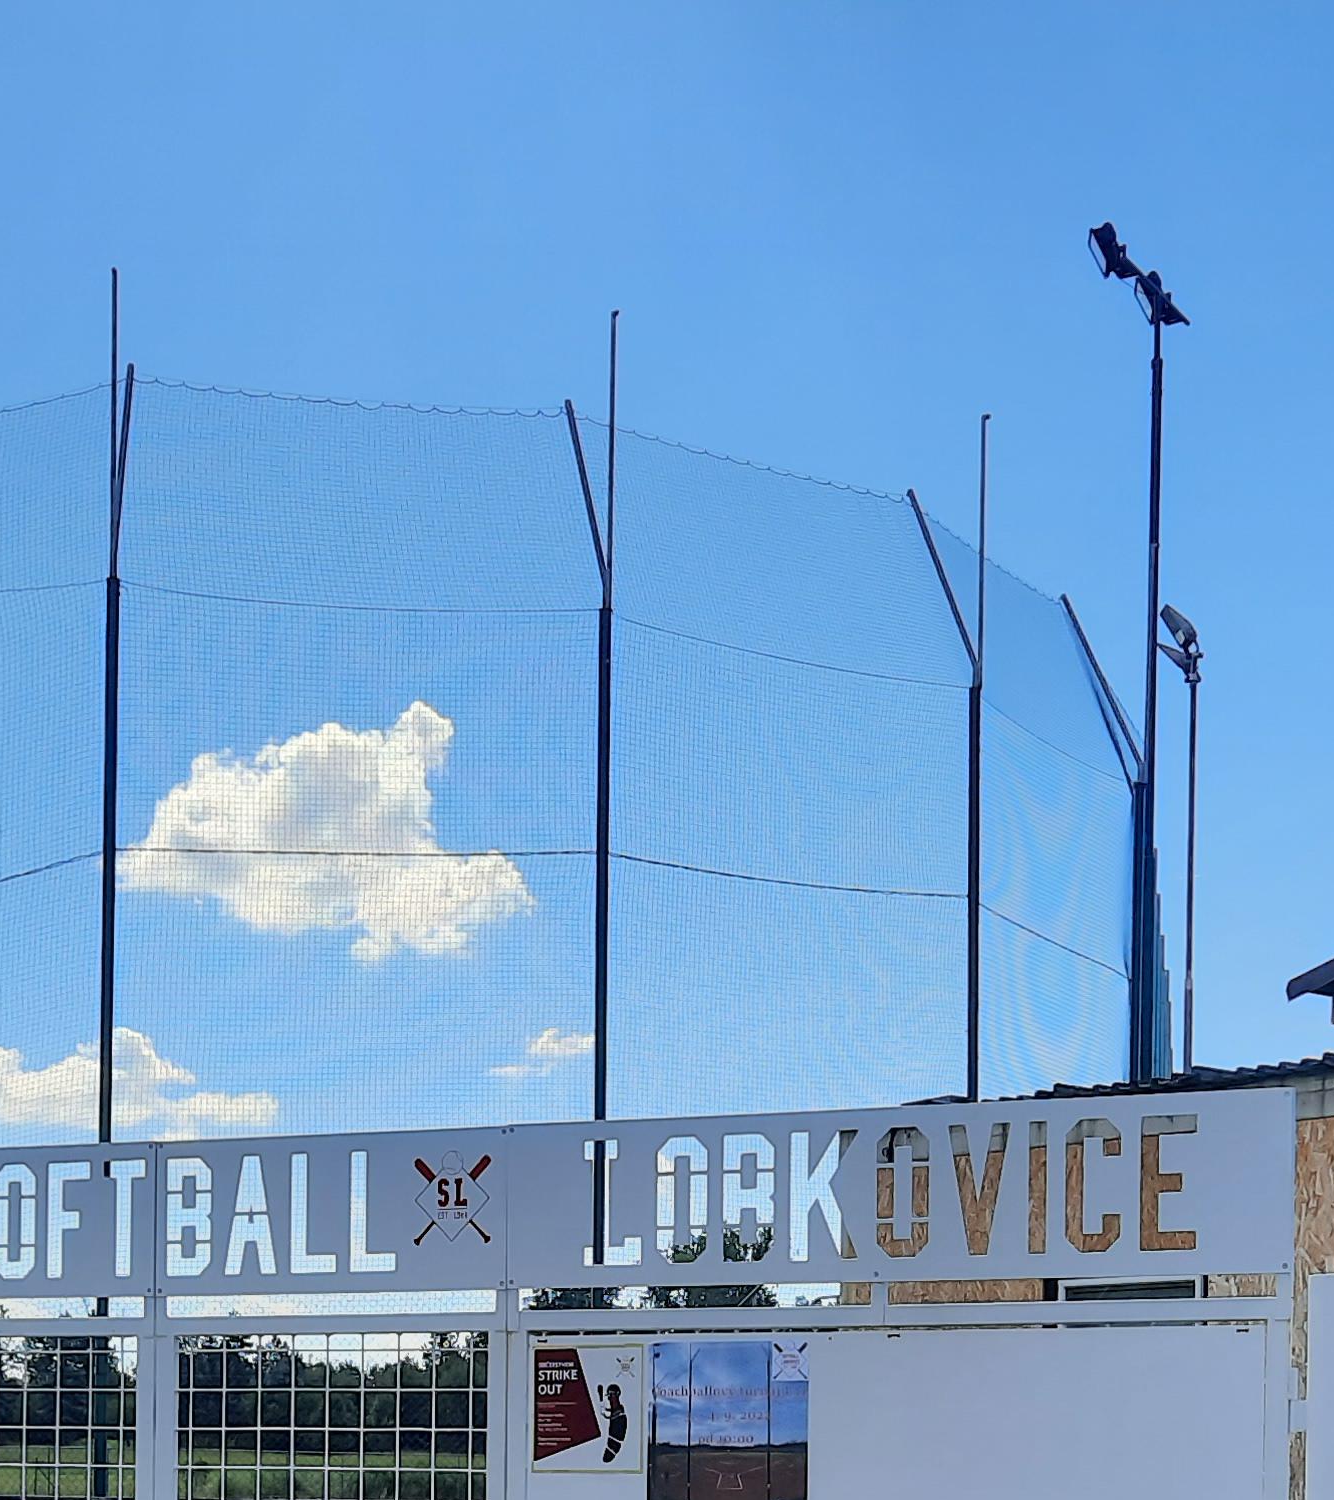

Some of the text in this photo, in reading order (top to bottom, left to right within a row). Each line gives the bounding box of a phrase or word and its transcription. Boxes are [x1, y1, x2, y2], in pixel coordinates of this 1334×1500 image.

[437, 1178, 467, 1207] SL
[583, 1114, 1198, 1266] LOBKOVICE
[538, 1369, 578, 1381] STRIKE
[538, 1384, 563, 1395] OUT
